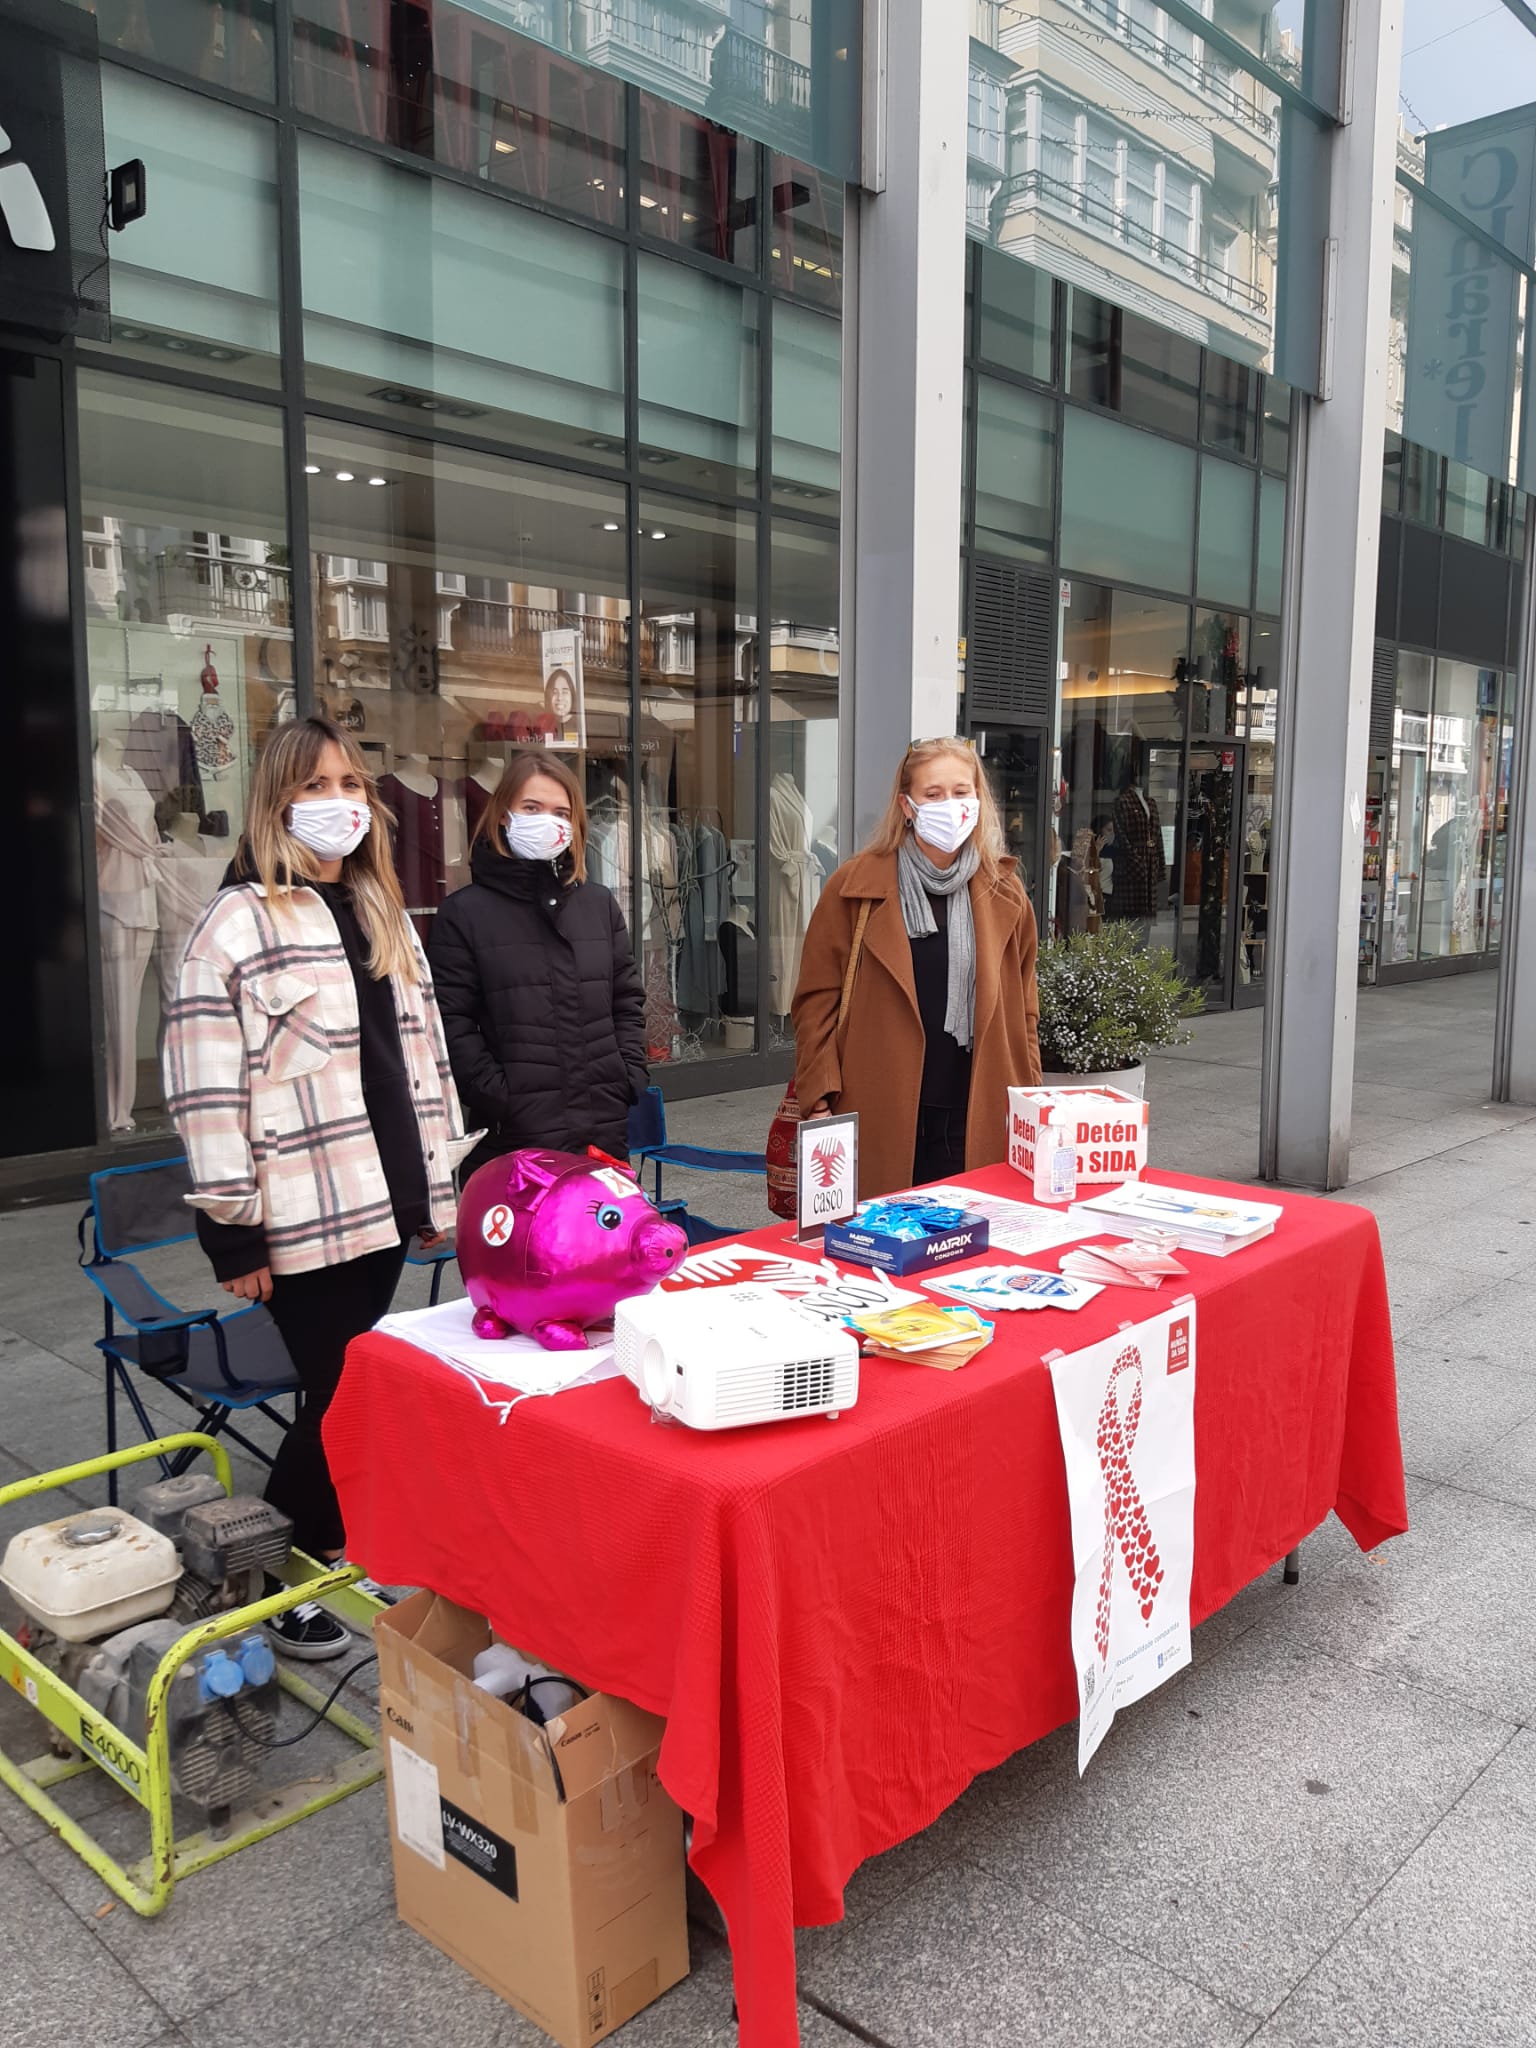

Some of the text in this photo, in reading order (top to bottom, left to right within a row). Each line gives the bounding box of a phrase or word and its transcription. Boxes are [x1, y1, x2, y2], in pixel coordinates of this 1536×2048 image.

[1013, 1113, 1036, 1144] Detén
[1076, 1119, 1138, 1143] Detén
[1088, 1149, 1137, 1173] SIDA
[813, 1187, 843, 1215] casco
[926, 1232, 973, 1256] MATRIX
[386, 1706, 415, 1735] Can
